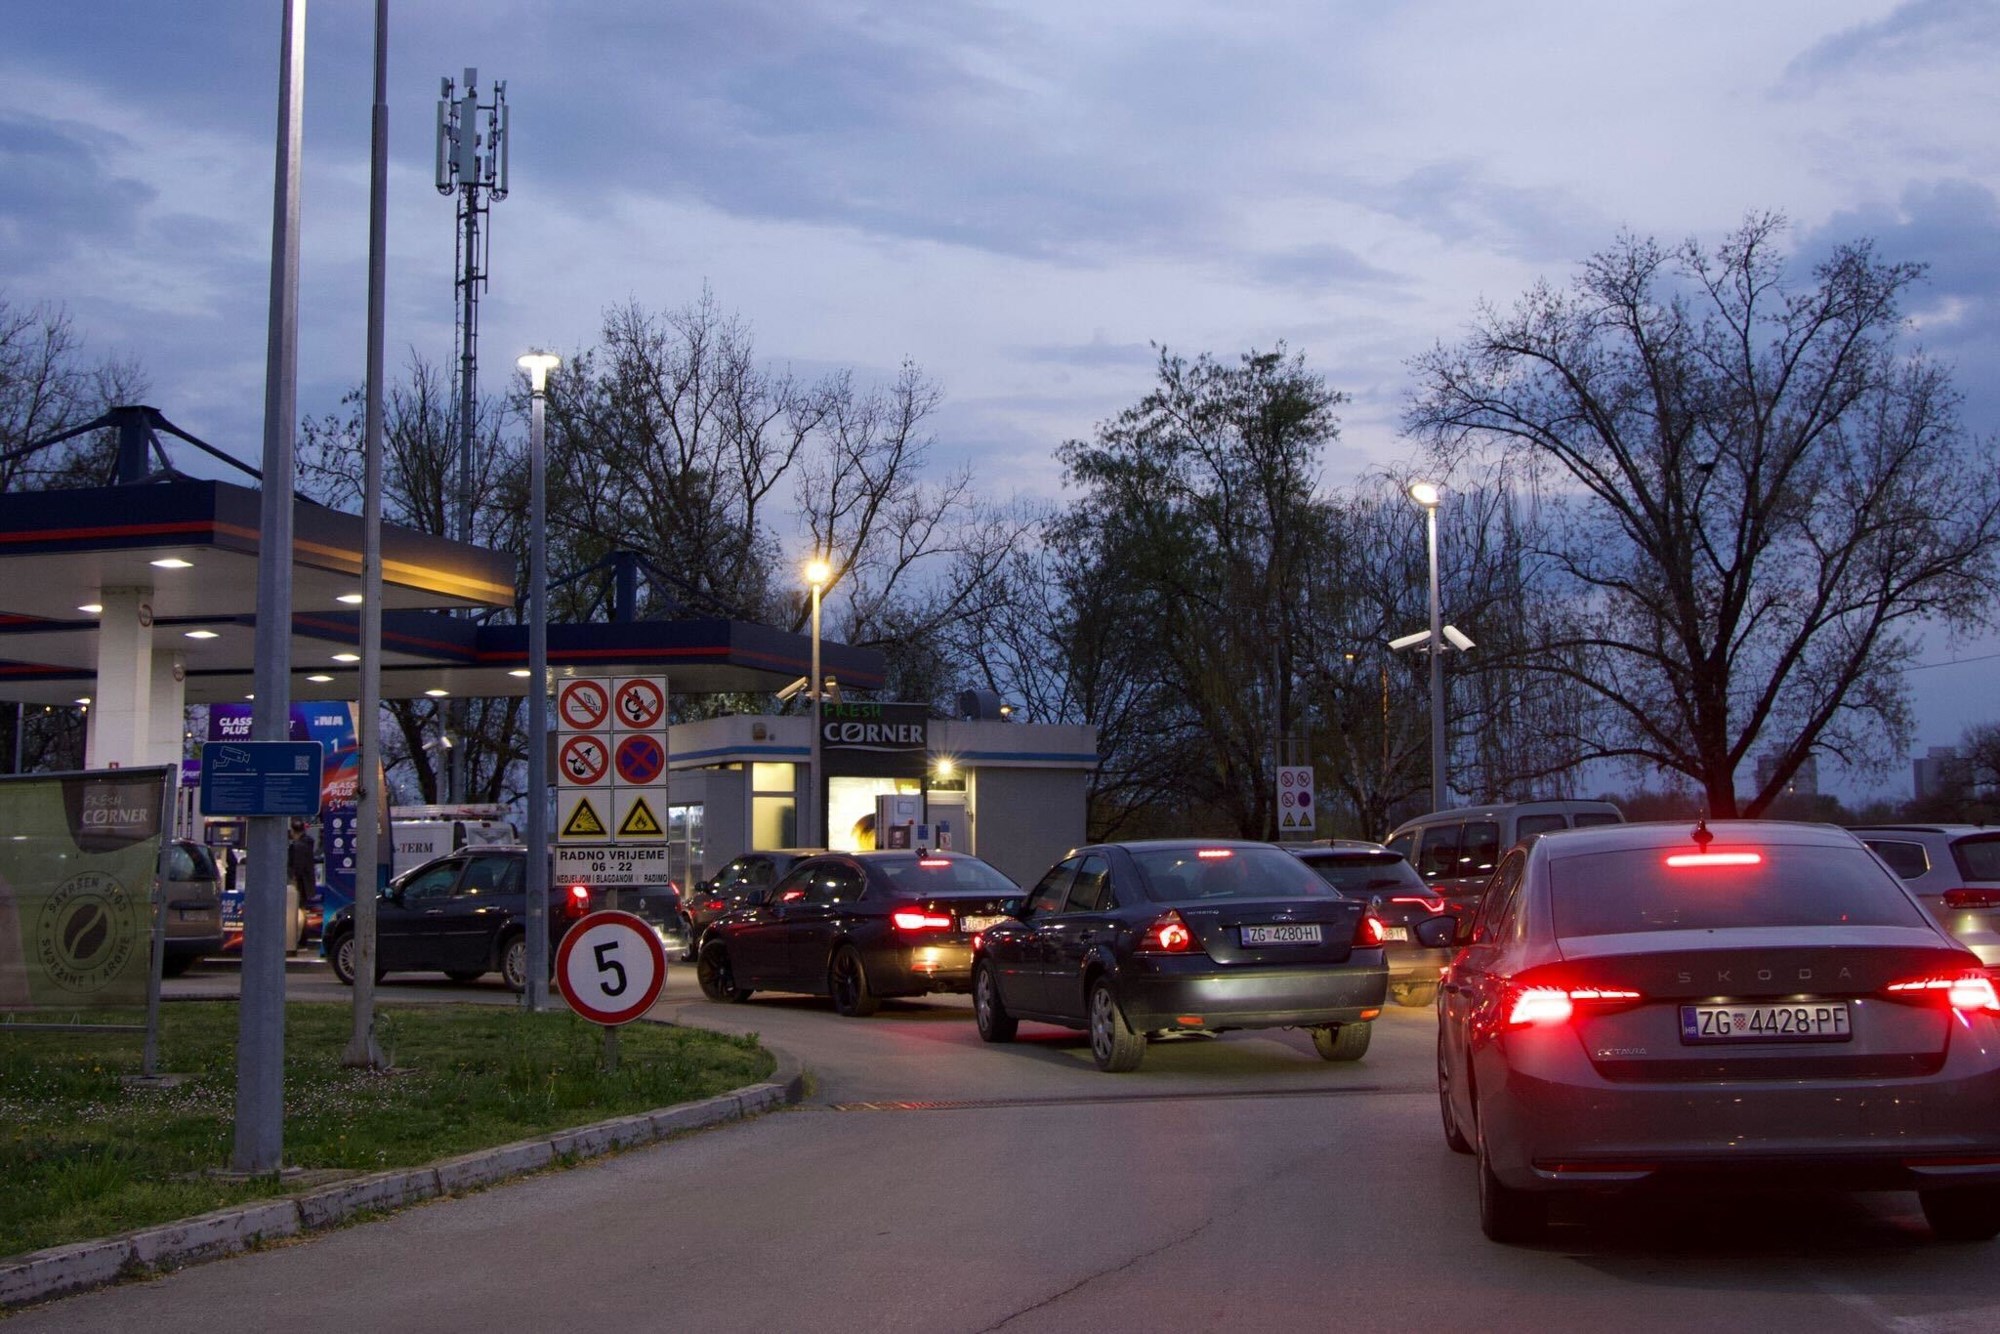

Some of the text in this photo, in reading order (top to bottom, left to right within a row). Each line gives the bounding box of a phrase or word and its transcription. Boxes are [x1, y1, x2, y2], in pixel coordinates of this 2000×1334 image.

[219, 717, 252, 726] CLASS
[222, 726, 249, 735] PLUS
[330, 738, 339, 753] 1
[560, 850, 665, 860] RADNO VRIJEME
[592, 862, 606, 871] 06
[618, 862, 632, 871] 22
[1250, 928, 1265, 942] ZG
[594, 941, 627, 997] 5
[1699, 1010, 1730, 1036] ZG
